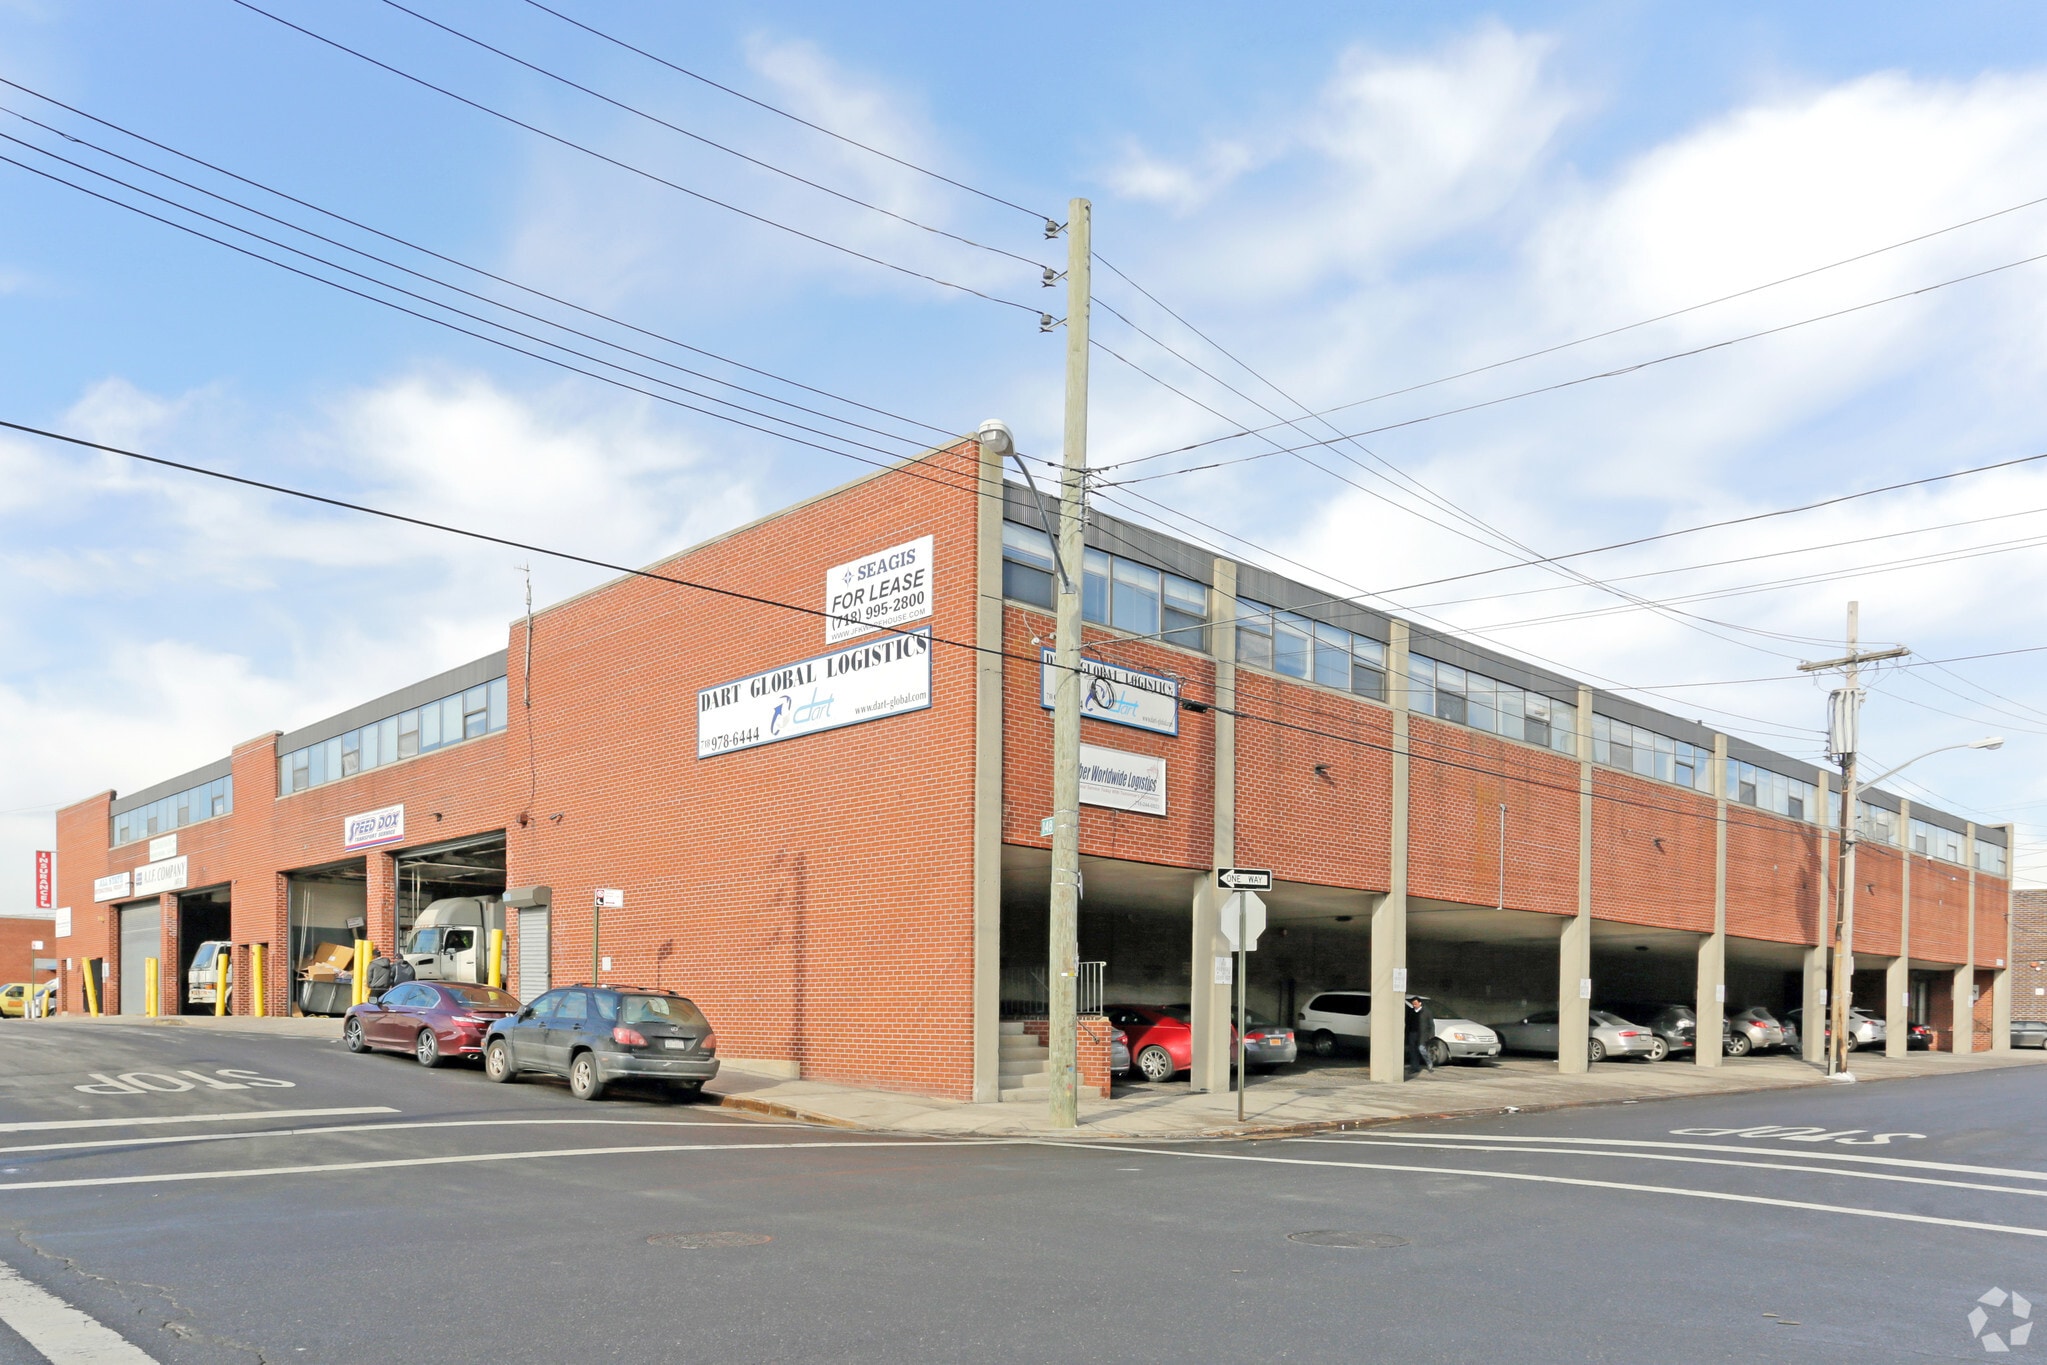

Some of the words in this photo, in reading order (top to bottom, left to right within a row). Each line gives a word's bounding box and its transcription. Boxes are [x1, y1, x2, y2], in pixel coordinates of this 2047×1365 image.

[857, 548, 916, 581] SEAGIS
[831, 592, 865, 613] FOR
[869, 569, 925, 602] LEASE
[831, 609, 862, 631] (718)
[866, 591, 925, 620] 995-2800
[701, 684, 741, 712] DART
[750, 664, 816, 698] GLOBAL
[827, 631, 927, 678] LOGISTICS
[793, 687, 834, 725] dart
[854, 691, 927, 715] www.dart-global.com
[711, 727, 760, 751] 978-6444
[1079, 762, 1091, 780] ber
[1091, 765, 1127, 787] Worldwide
[1127, 772, 1158, 792] Logistics
[348, 818, 376, 843] SPEED
[378, 813, 400, 830] DOX
[39, 852, 49, 901] INSURANCE
[157, 862, 185, 881] COMPANY
[1226, 874, 1241, 883] ONE
[1248, 875, 1263, 884] WAY
[74, 1069, 296, 1094] STOP
[1669, 1126, 1927, 1145] STOP
